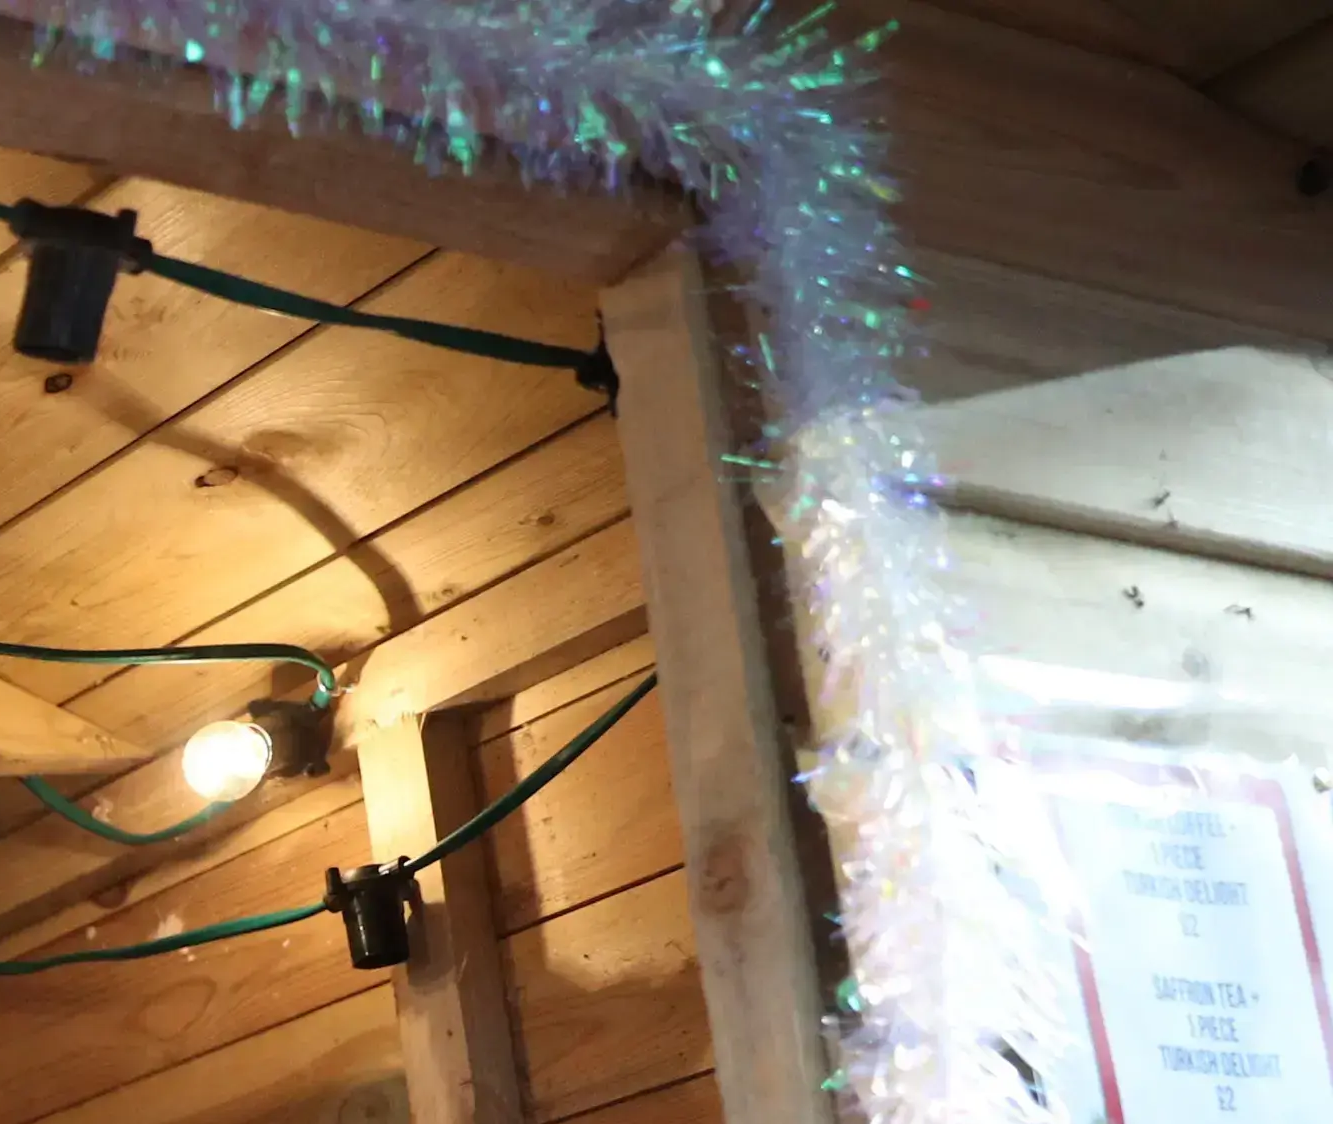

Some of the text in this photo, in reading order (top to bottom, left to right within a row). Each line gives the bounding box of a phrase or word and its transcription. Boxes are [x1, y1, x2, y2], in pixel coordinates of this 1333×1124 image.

[1217, 982, 1247, 1009] TEA
[1197, 1015, 1239, 1042] PIECE
[1158, 1044, 1282, 1079] TURKISH DELIGHT
